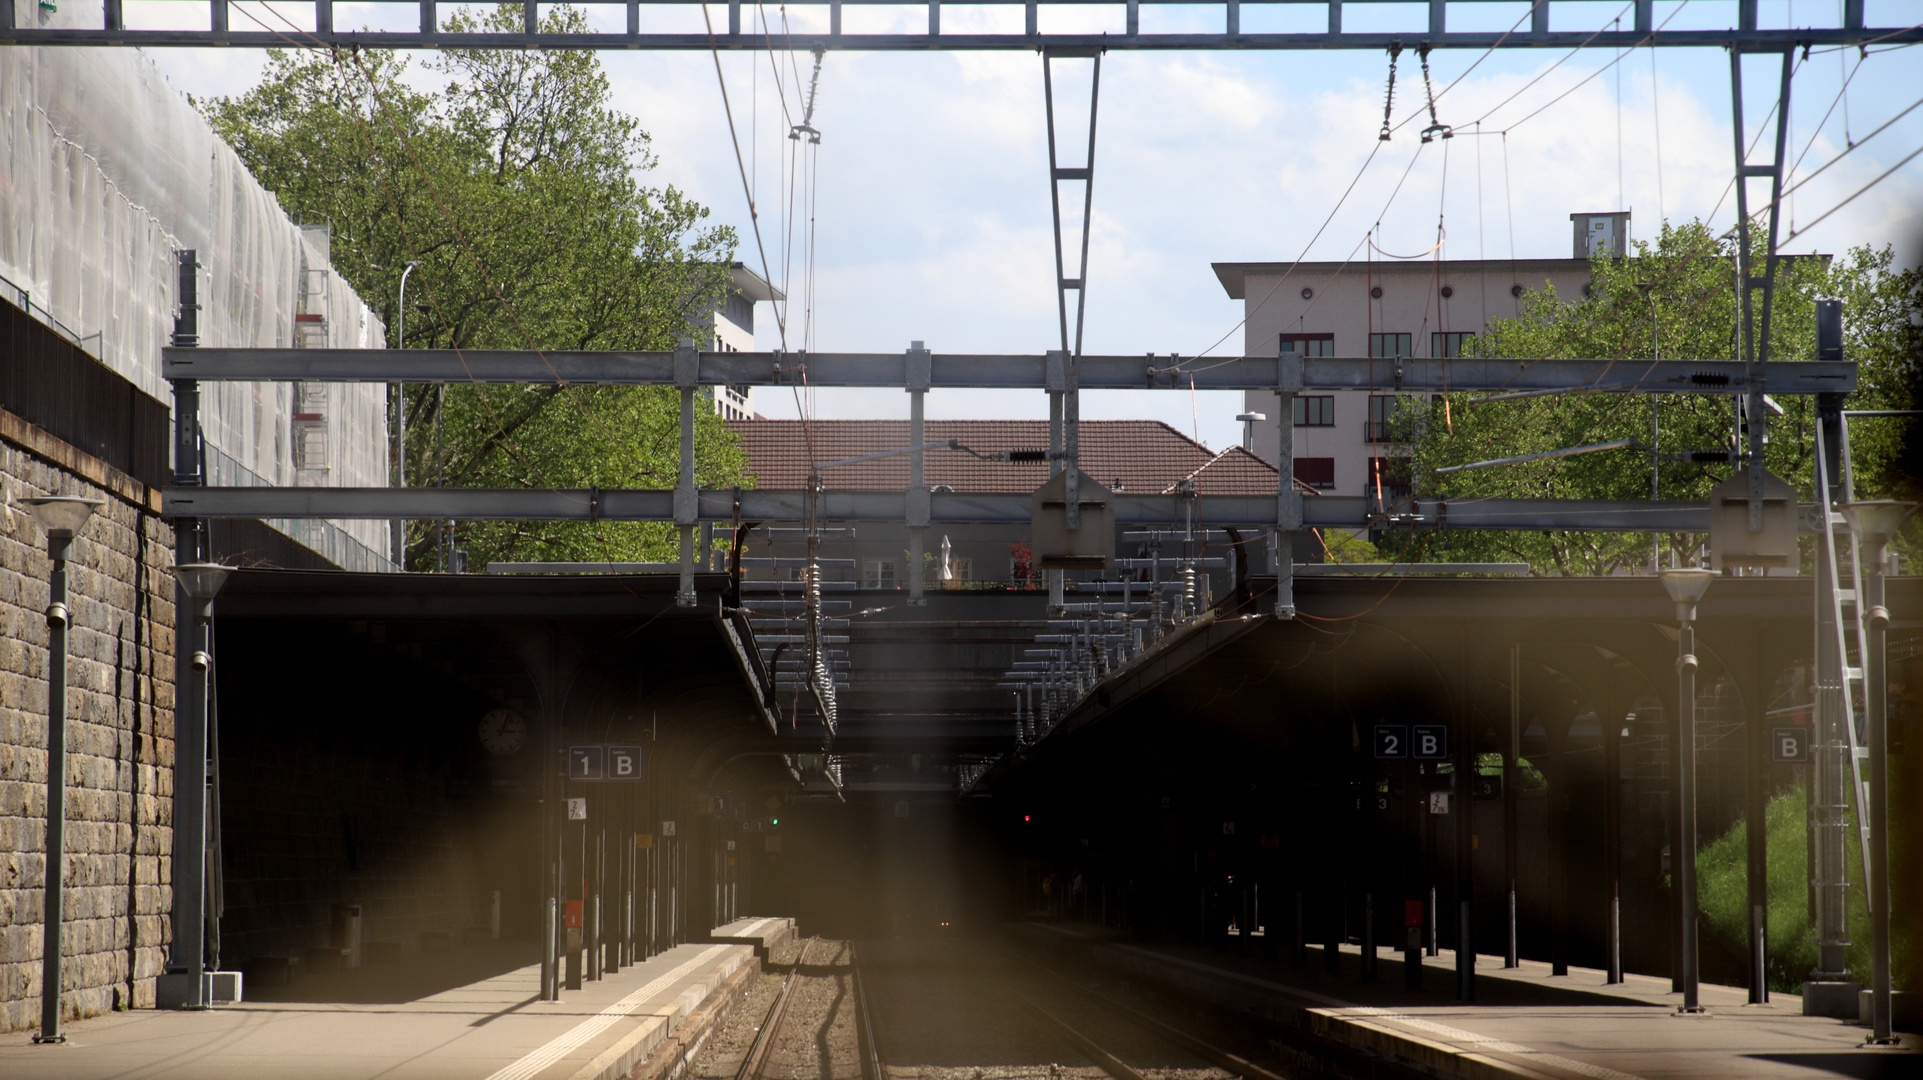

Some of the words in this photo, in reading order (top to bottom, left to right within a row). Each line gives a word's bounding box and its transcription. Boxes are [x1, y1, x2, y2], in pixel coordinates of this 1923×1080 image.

[1384, 735, 1398, 754] 2
[1422, 735, 1438, 754] B
[1782, 738, 1798, 757] B
[581, 756, 589, 775] 1
[617, 756, 633, 775] B
[1435, 794, 1440, 803] 2
[1484, 784, 1492, 795] 3
[718, 798, 724, 810] 1
[1378, 798, 1387, 809] 3
